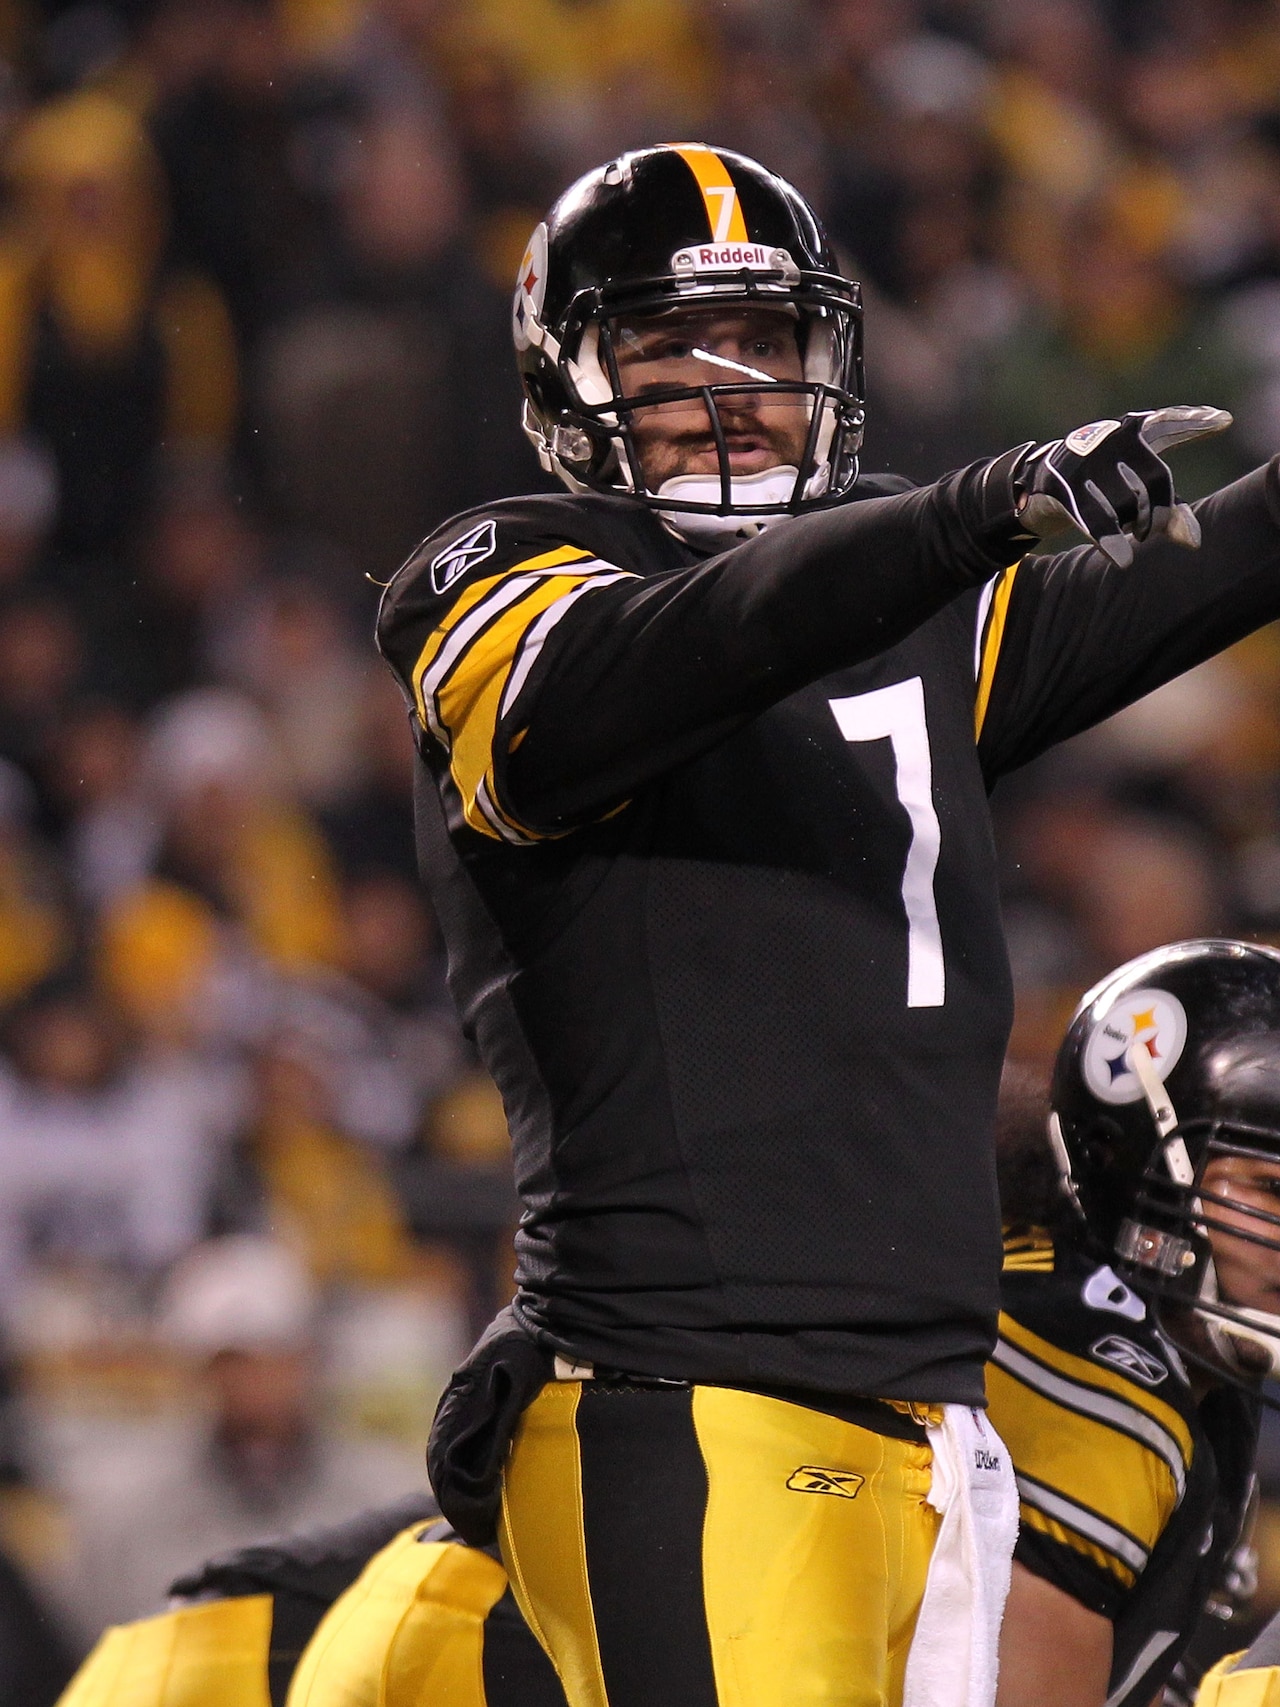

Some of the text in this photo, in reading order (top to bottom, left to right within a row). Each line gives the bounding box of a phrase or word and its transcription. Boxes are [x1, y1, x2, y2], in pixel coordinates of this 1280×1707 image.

[705, 186, 736, 243] 7
[699, 247, 765, 265] Riddell
[828, 675, 946, 1008] 7
